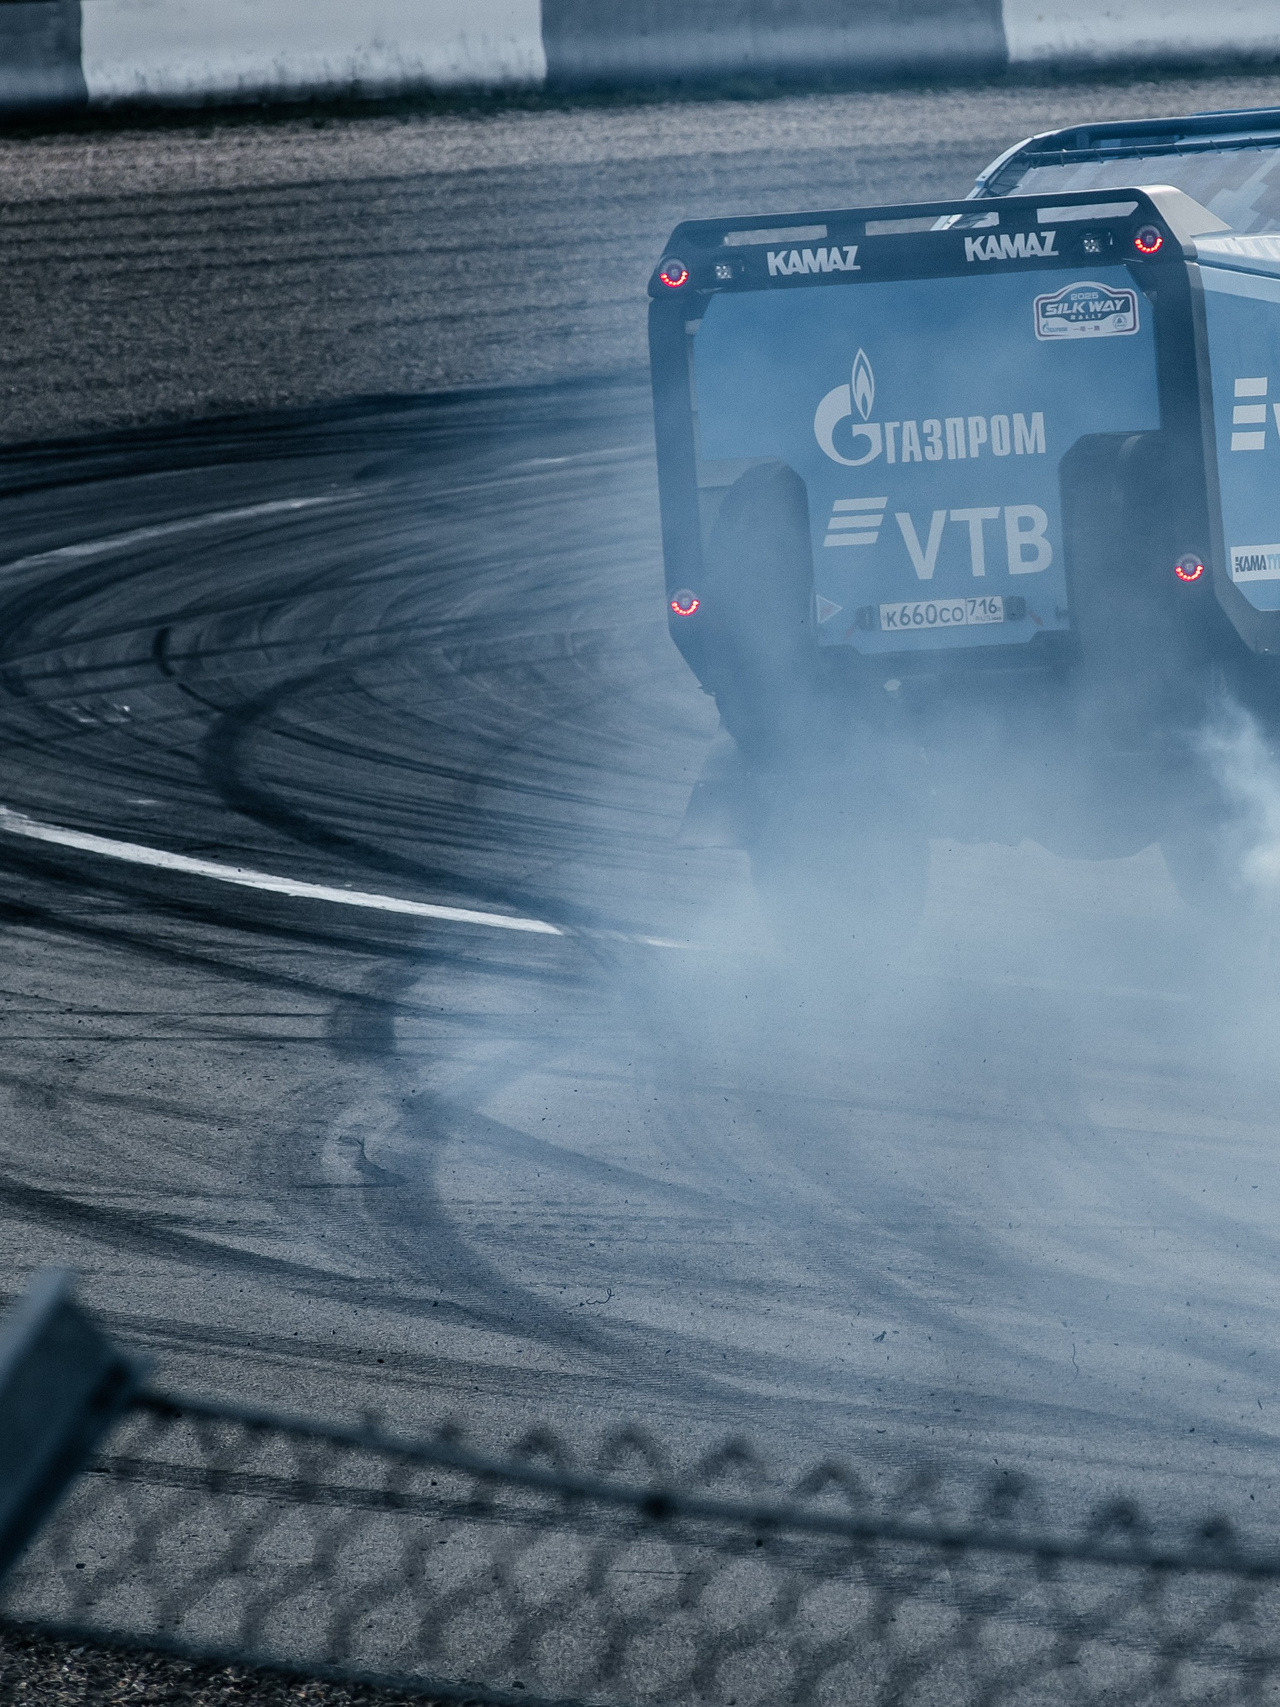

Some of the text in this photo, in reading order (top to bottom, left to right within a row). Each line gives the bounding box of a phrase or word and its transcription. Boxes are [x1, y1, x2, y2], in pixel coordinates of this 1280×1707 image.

[964, 231, 1059, 262] KAMAZ
[767, 245, 861, 276] KAMAZ
[1045, 299, 1125, 315] SILK WAY
[1071, 292, 1099, 300] 2025
[894, 503, 1053, 580] VTB
[967, 597, 998, 616] 716
